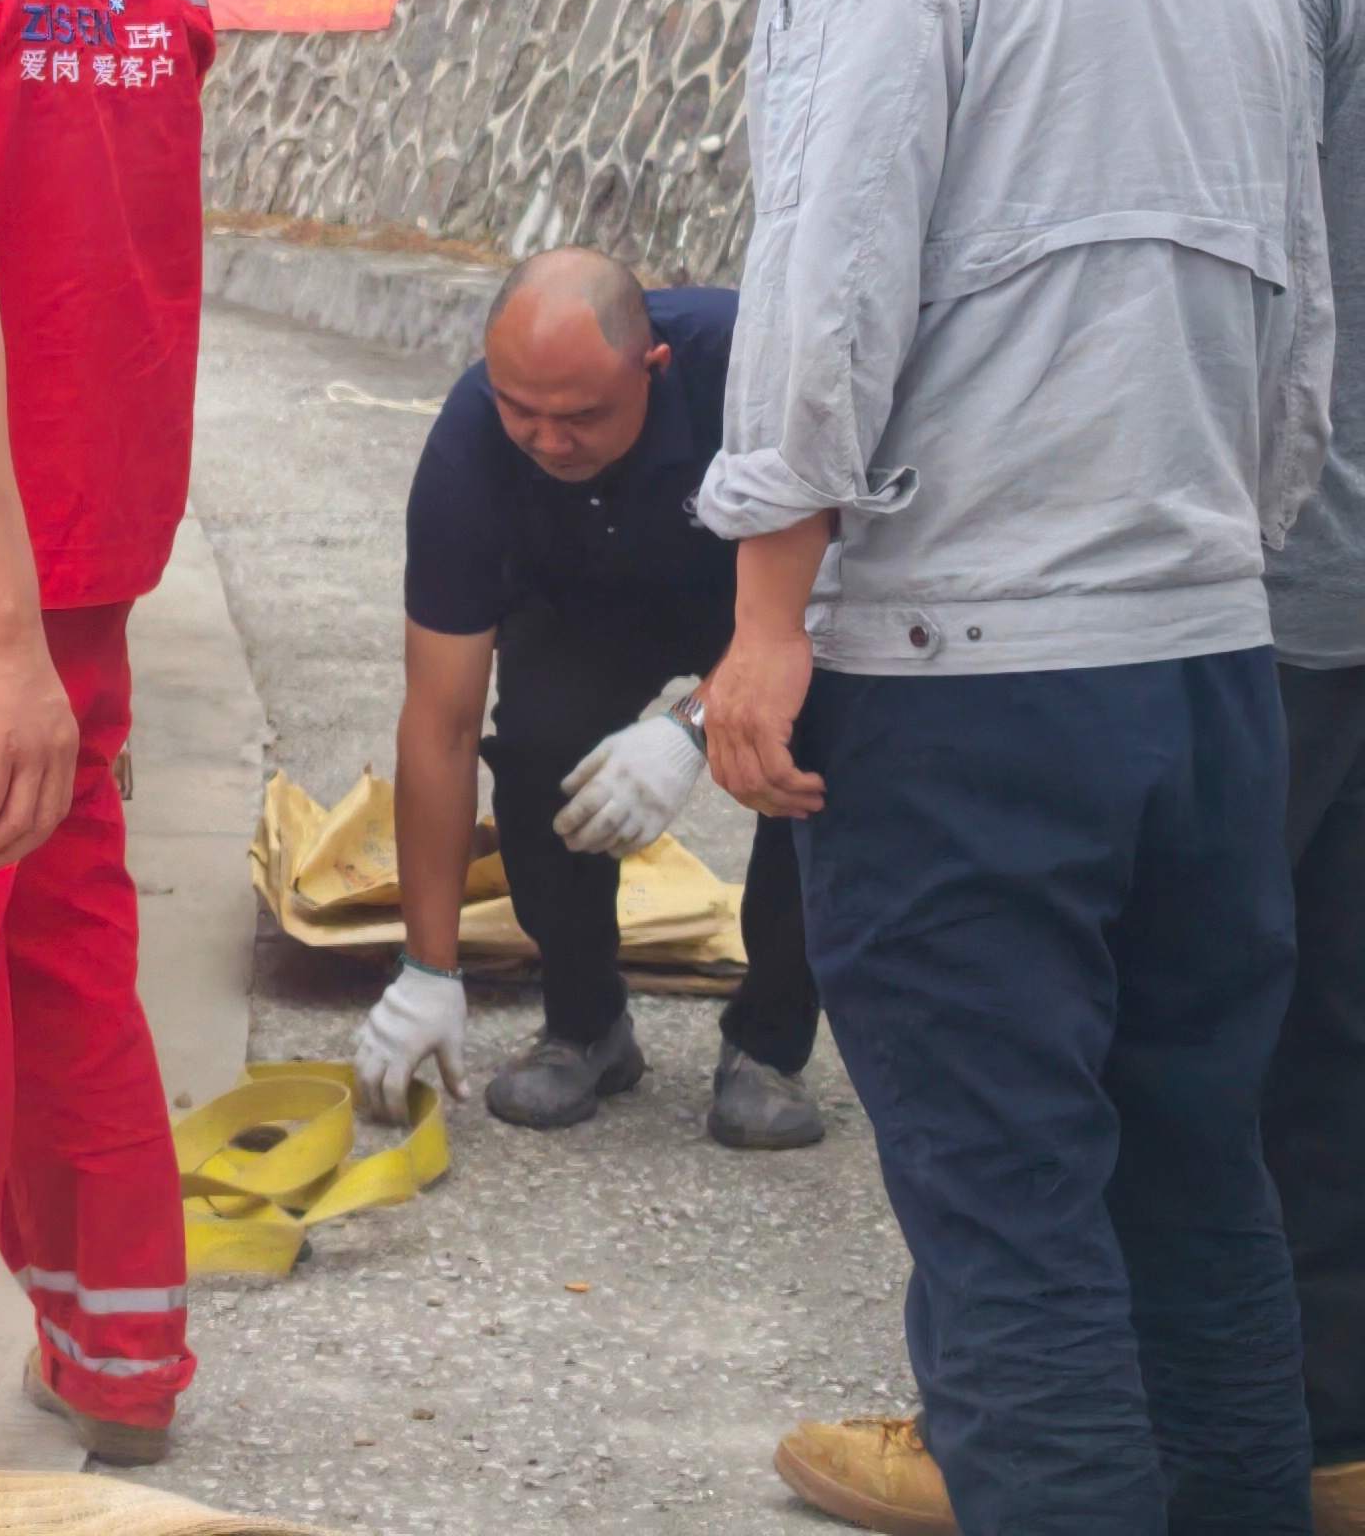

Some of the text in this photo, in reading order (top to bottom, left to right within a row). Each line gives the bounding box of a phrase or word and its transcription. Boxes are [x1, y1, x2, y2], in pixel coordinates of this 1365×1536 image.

[20, 2, 117, 46] ZISEN
[124, 22, 174, 51] 正升
[20, 49, 175, 89] 爱岗 爱客户
